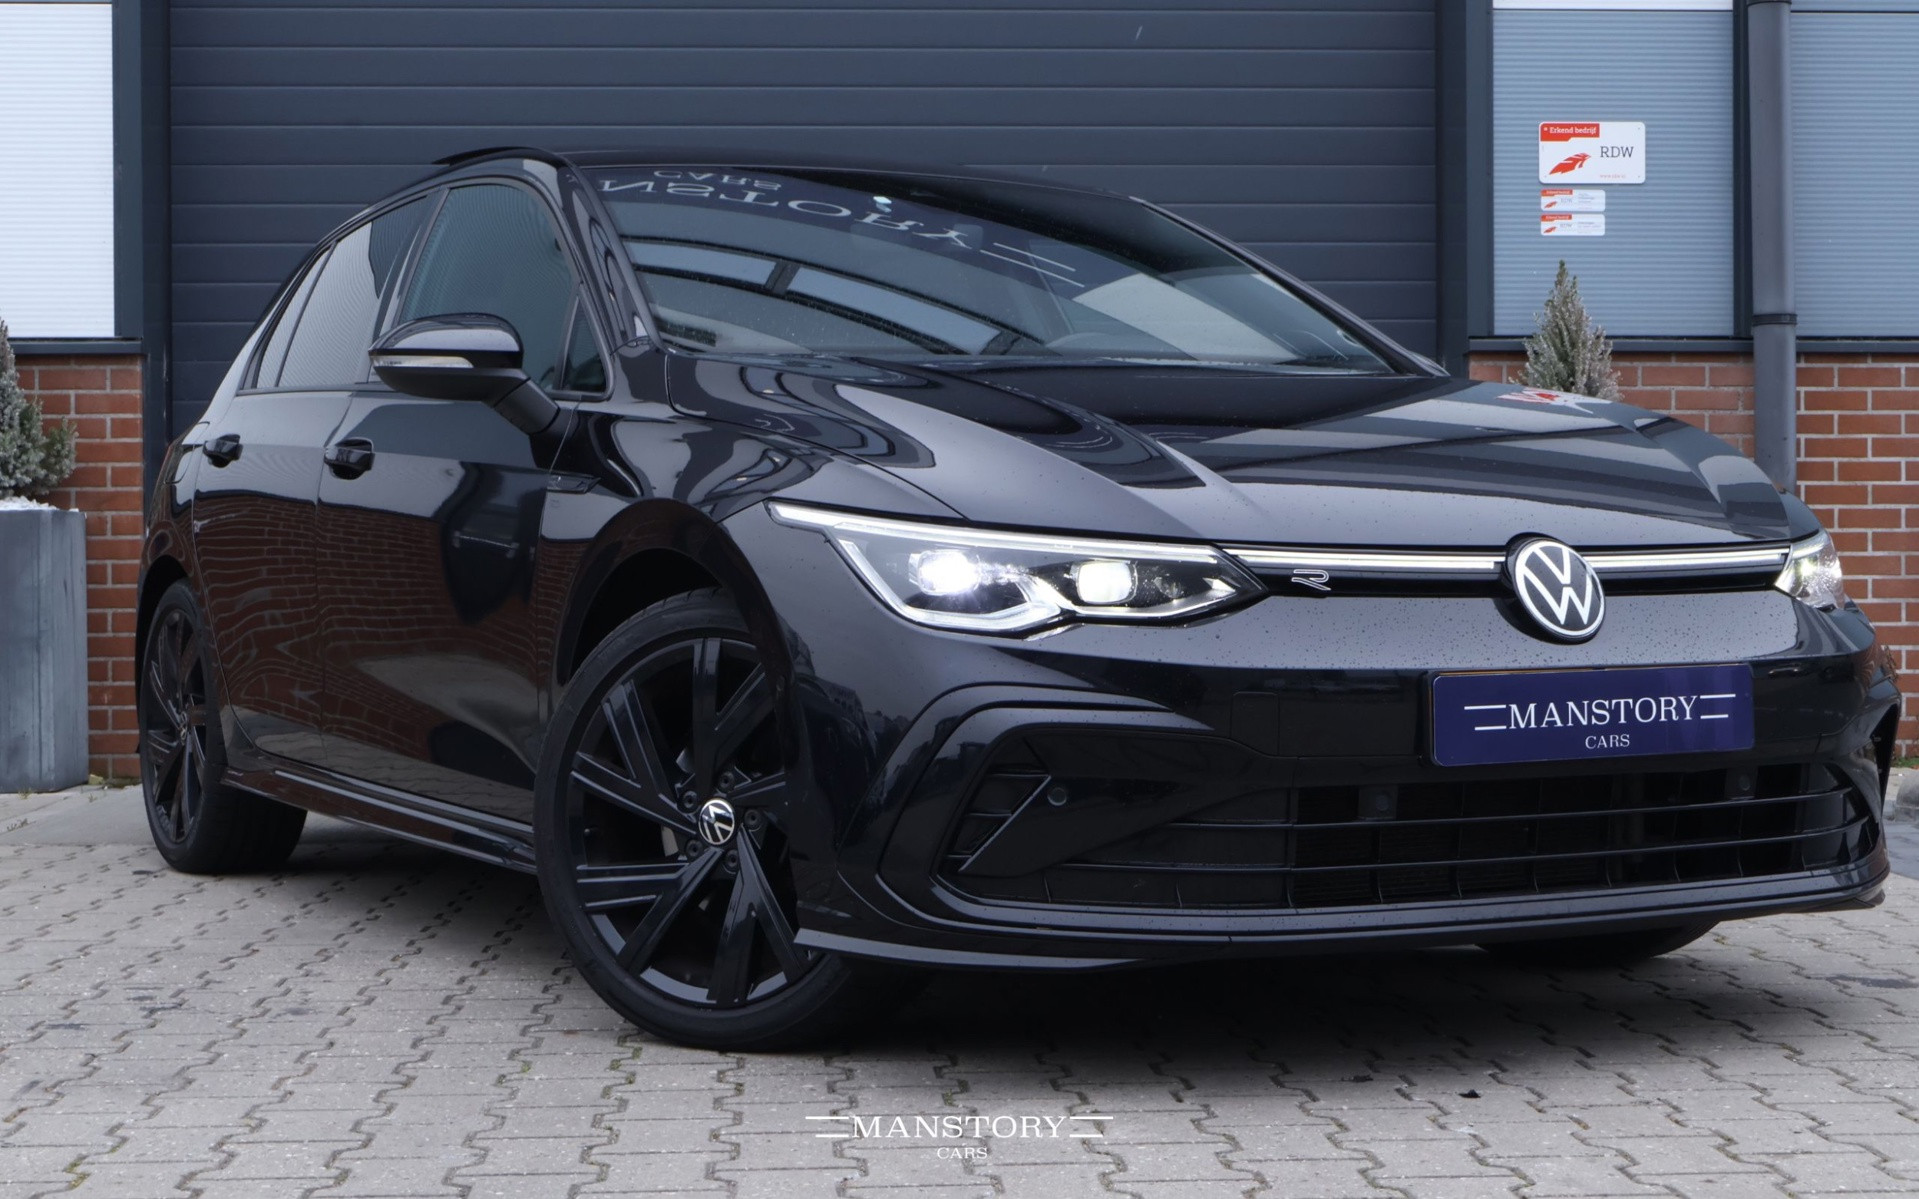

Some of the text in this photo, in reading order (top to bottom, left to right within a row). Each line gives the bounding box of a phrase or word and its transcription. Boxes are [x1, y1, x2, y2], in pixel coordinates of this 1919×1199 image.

[1549, 126, 1597, 135] Erkend bedrijf
[1599, 146, 1634, 158] RDW
[1508, 695, 1698, 730] MANSTORY
[1584, 733, 1631, 750] CARS
